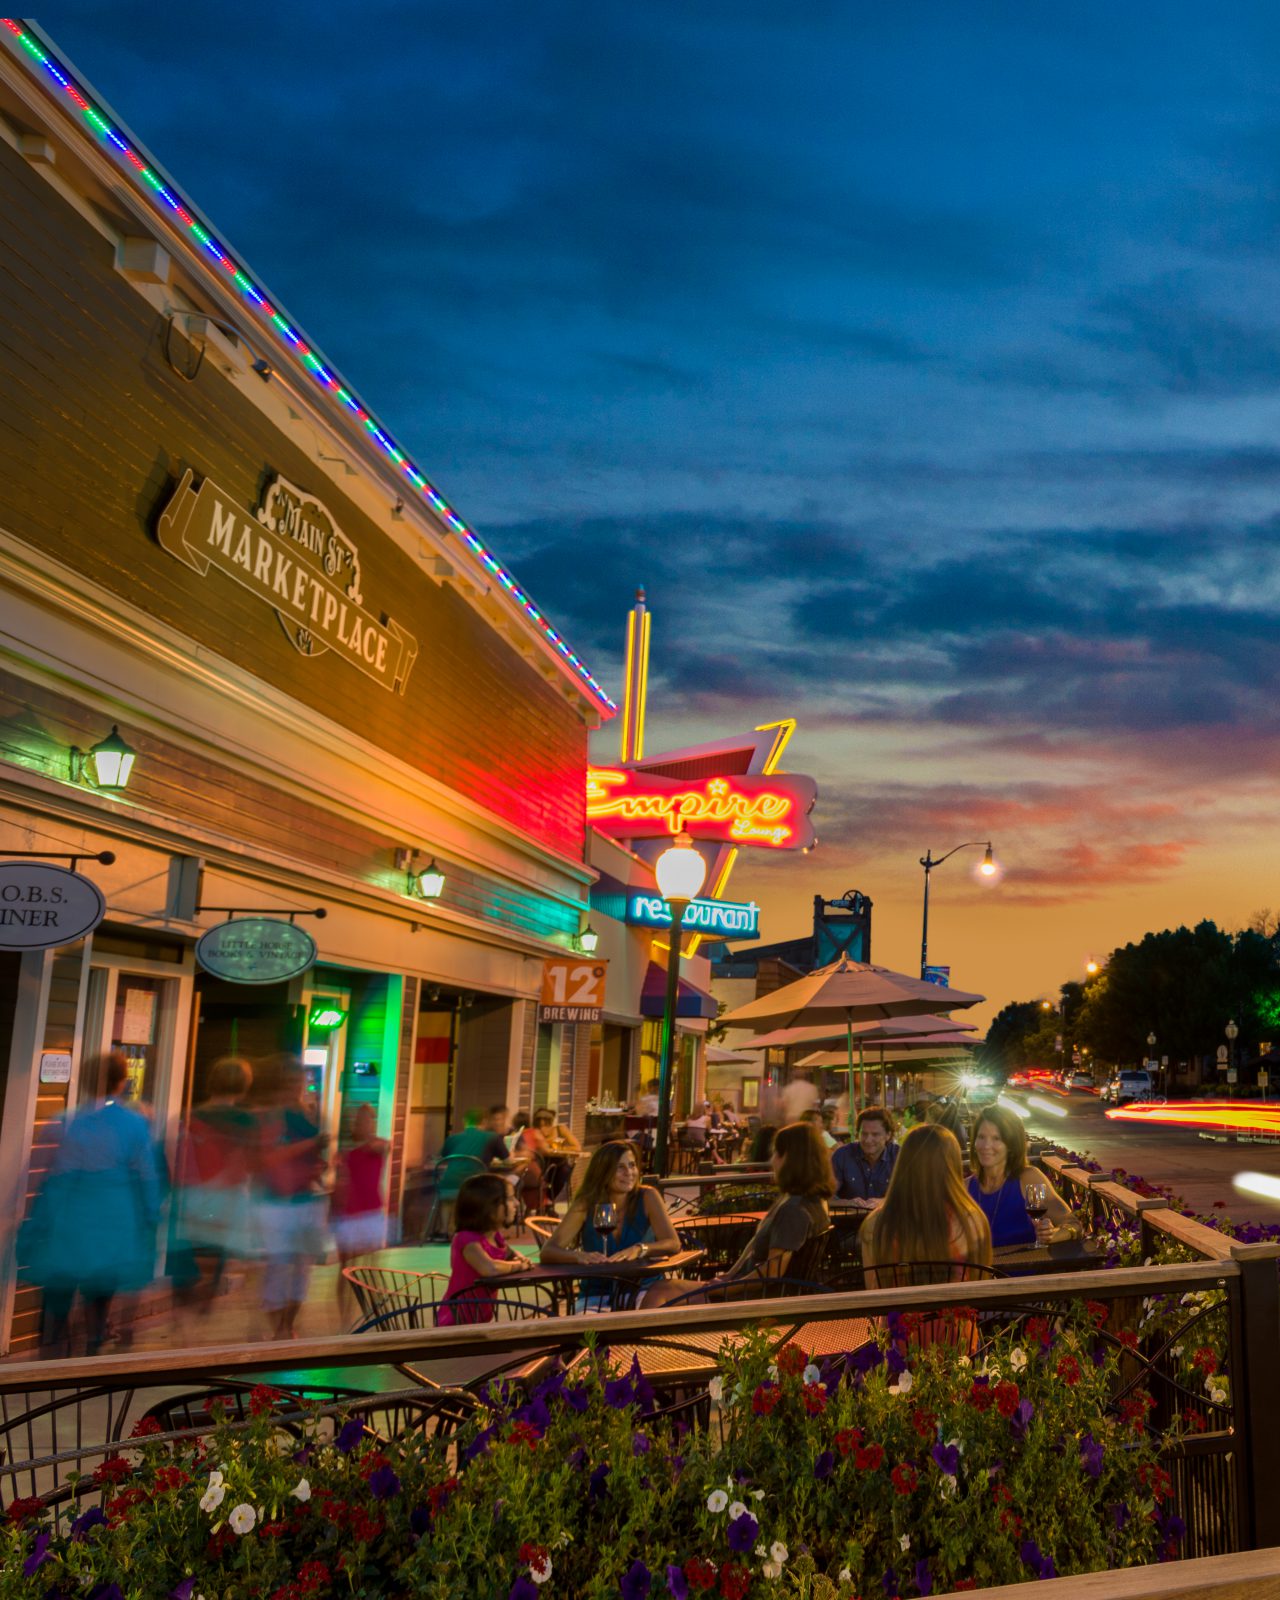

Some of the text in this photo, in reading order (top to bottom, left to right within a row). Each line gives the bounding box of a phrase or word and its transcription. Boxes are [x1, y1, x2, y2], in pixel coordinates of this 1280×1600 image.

[279, 498, 325, 557] MAIN
[207, 499, 389, 673] MARKETPLACE
[733, 819, 791, 844] Lounge
[207, 950, 242, 959] BOOKS
[221, 941, 257, 950] LITTLE
[543, 1007, 600, 1021] BREWING
